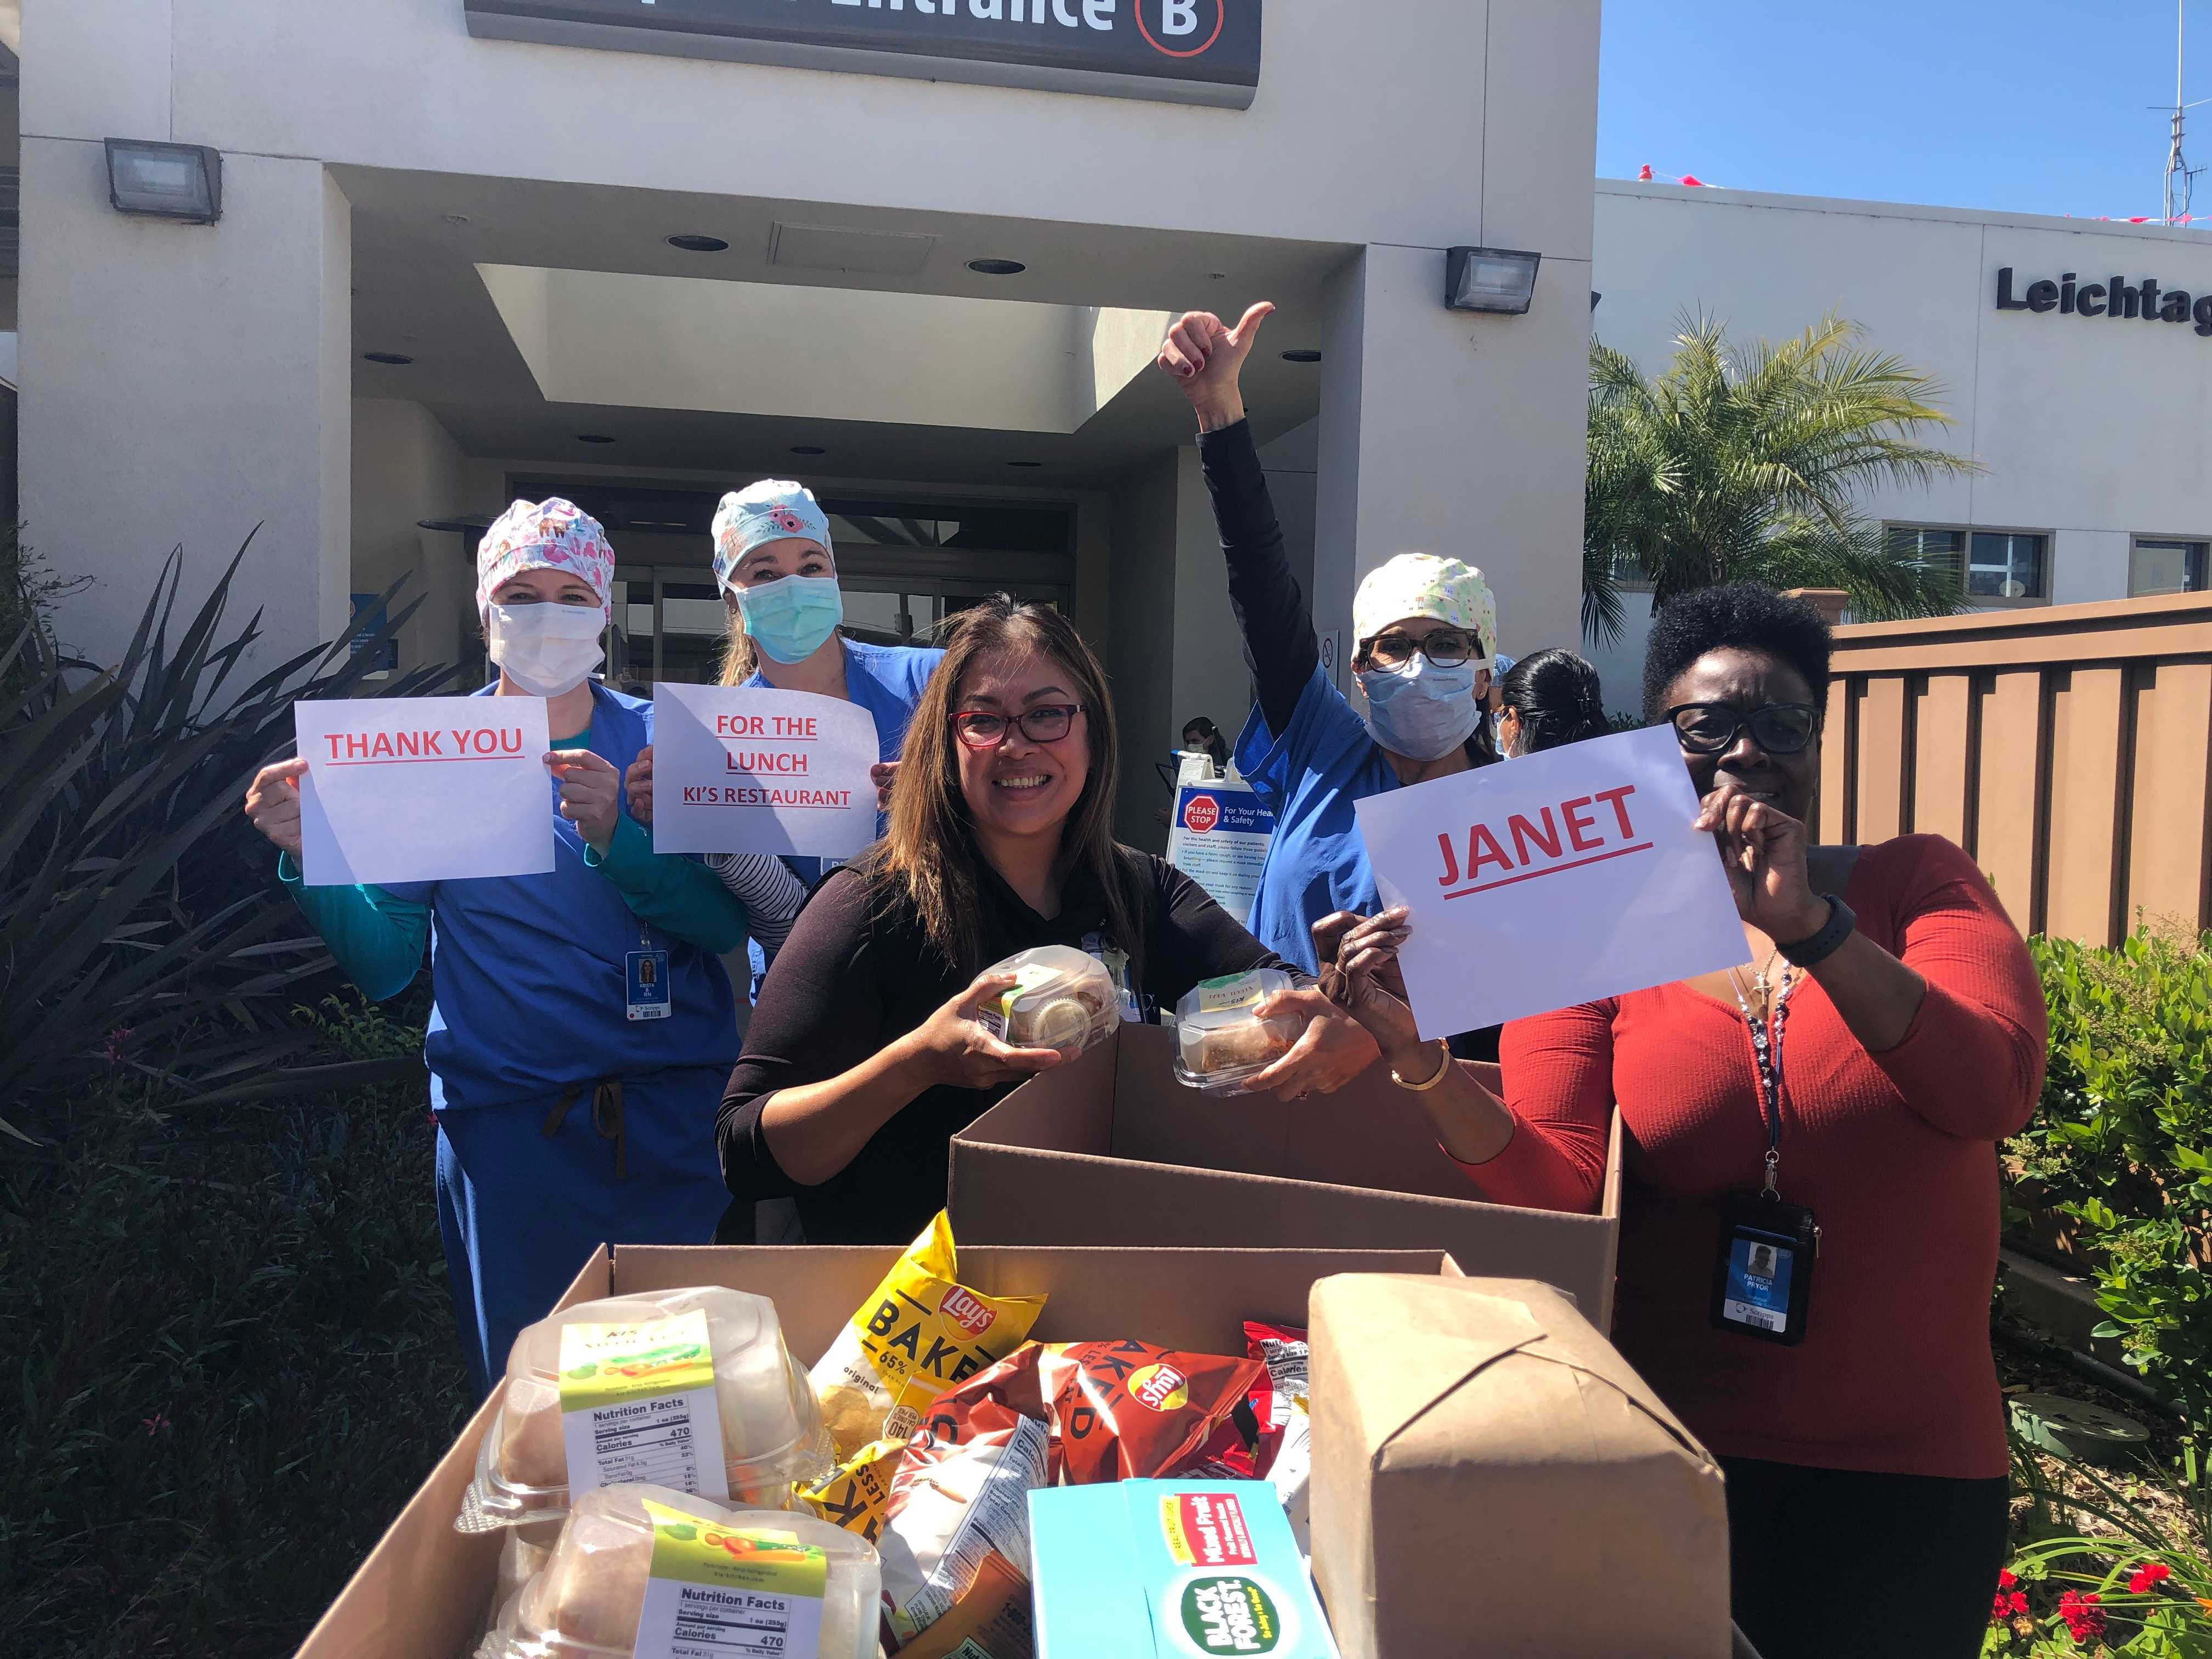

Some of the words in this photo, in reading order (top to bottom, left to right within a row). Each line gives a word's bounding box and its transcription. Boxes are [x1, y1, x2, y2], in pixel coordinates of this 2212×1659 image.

[1163, 0, 1198, 35] B
[716, 714, 764, 736] FOR
[772, 715, 817, 737] THE
[324, 730, 442, 759] THANK
[451, 728, 522, 755] YOU
[727, 751, 808, 772] LUNCH
[725, 787, 851, 806] RESTAURANT
[1188, 806, 1216, 815] PLEASE
[1190, 815, 1211, 823] STOP
[1238, 807, 1255, 816] Your
[1231, 816, 1254, 826] Safety
[1438, 785, 1635, 887] JANET
[1744, 1273, 1773, 1285] PATRICIA
[1747, 1281, 1769, 1291] PRYOR
[879, 1351, 908, 1375] 65%
[1270, 1366, 1308, 1378] Calories
[844, 1367, 879, 1394] original
[593, 1406, 647, 1421] Nutrition
[650, 1399, 684, 1412] Facts
[888, 1421, 909, 1438] 140
[893, 1413, 916, 1427] CALORIES
[596, 1440, 633, 1451] Calories
[670, 1427, 690, 1437] 470
[1008, 1455, 1022, 1468] Total
[856, 1464, 885, 1505] LESS
[986, 1495, 1000, 1508] Total
[989, 1489, 1009, 1506] Sodium
[992, 1484, 1020, 1509] Cholesterol
[973, 1517, 991, 1535] Protein
[681, 1588, 742, 1606] Nutrition
[747, 1596, 785, 1610] Facts
[685, 1603, 708, 1611] servings
[678, 1609, 704, 1618] Serving
[1194, 1585, 1233, 1646] BLACK
[1217, 1579, 1261, 1650] FOREST
[675, 1627, 716, 1640] Calories
[760, 1635, 783, 1646] 470
